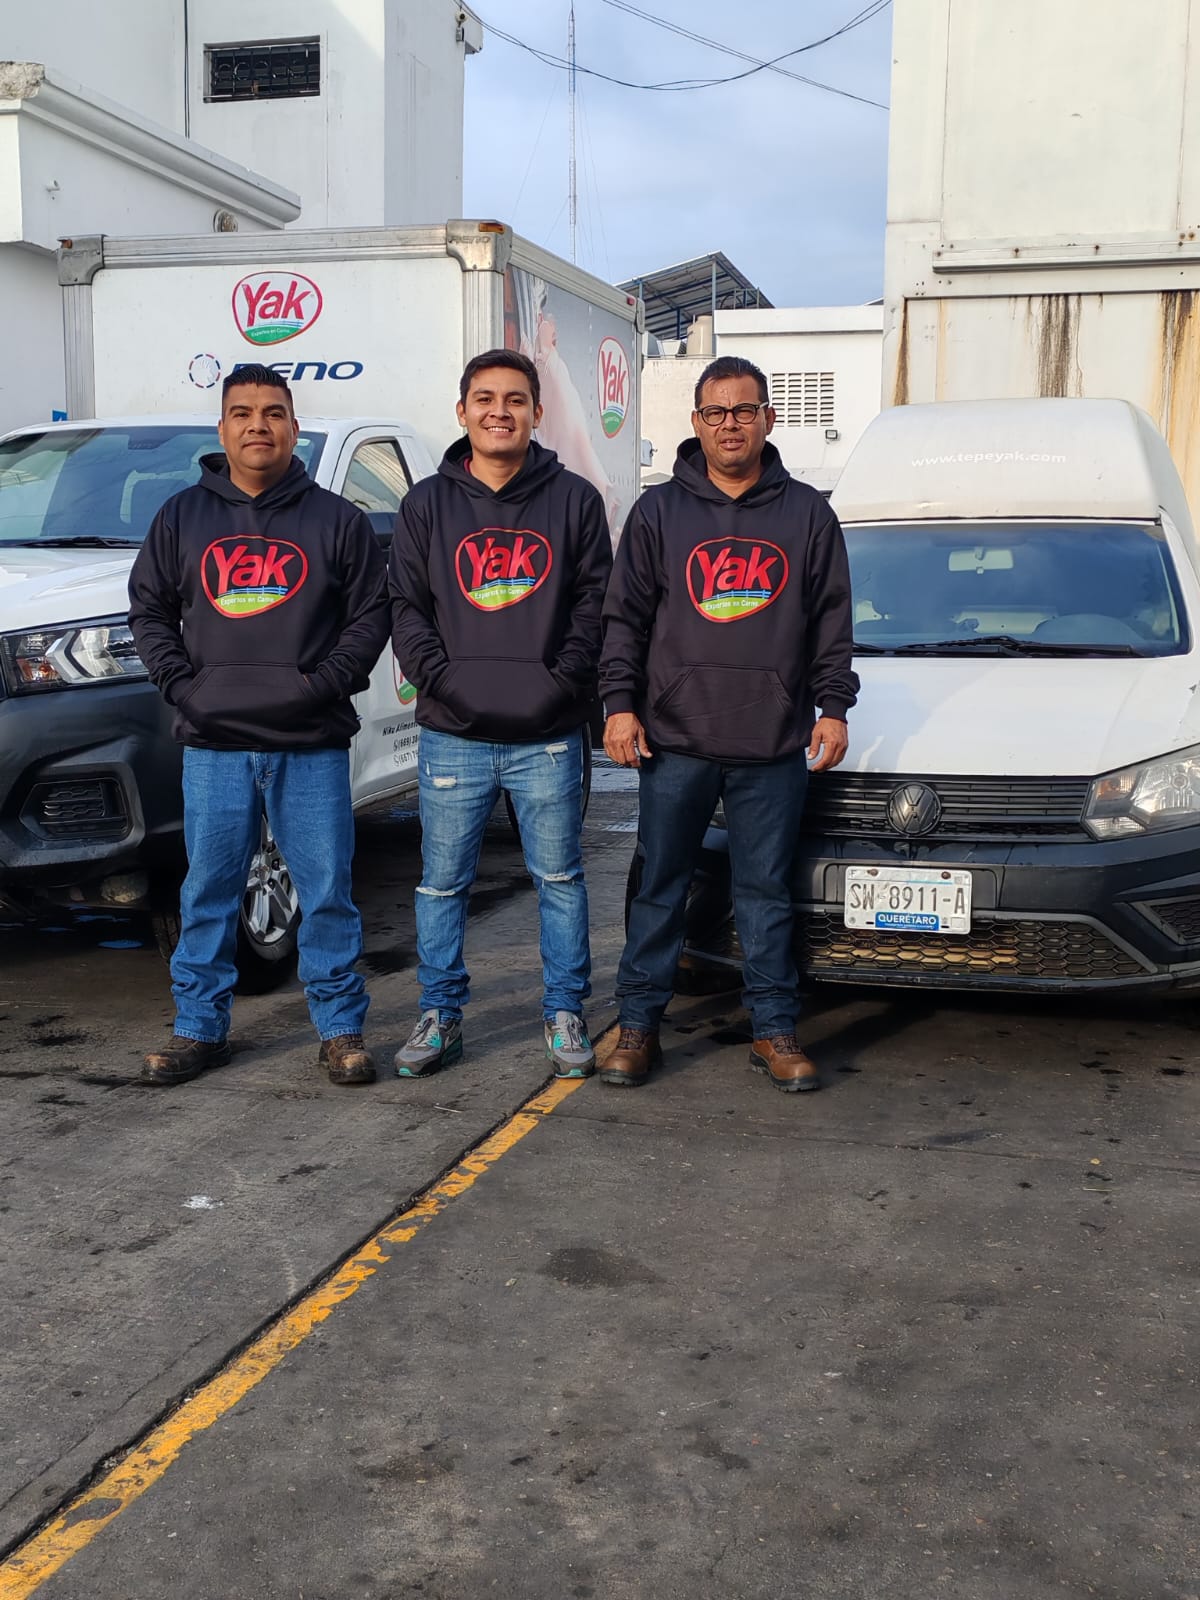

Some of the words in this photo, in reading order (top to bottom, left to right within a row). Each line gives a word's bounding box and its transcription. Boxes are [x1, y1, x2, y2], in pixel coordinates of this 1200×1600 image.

[242, 280, 312, 327] Yak
[601, 350, 627, 410] Yak
[911, 450, 1067, 468] www.tepeyak.com
[211, 543, 296, 595] Yak
[465, 536, 541, 589] Yak
[695, 546, 778, 600] Yak
[877, 912, 937, 925] QUERÉTARO
